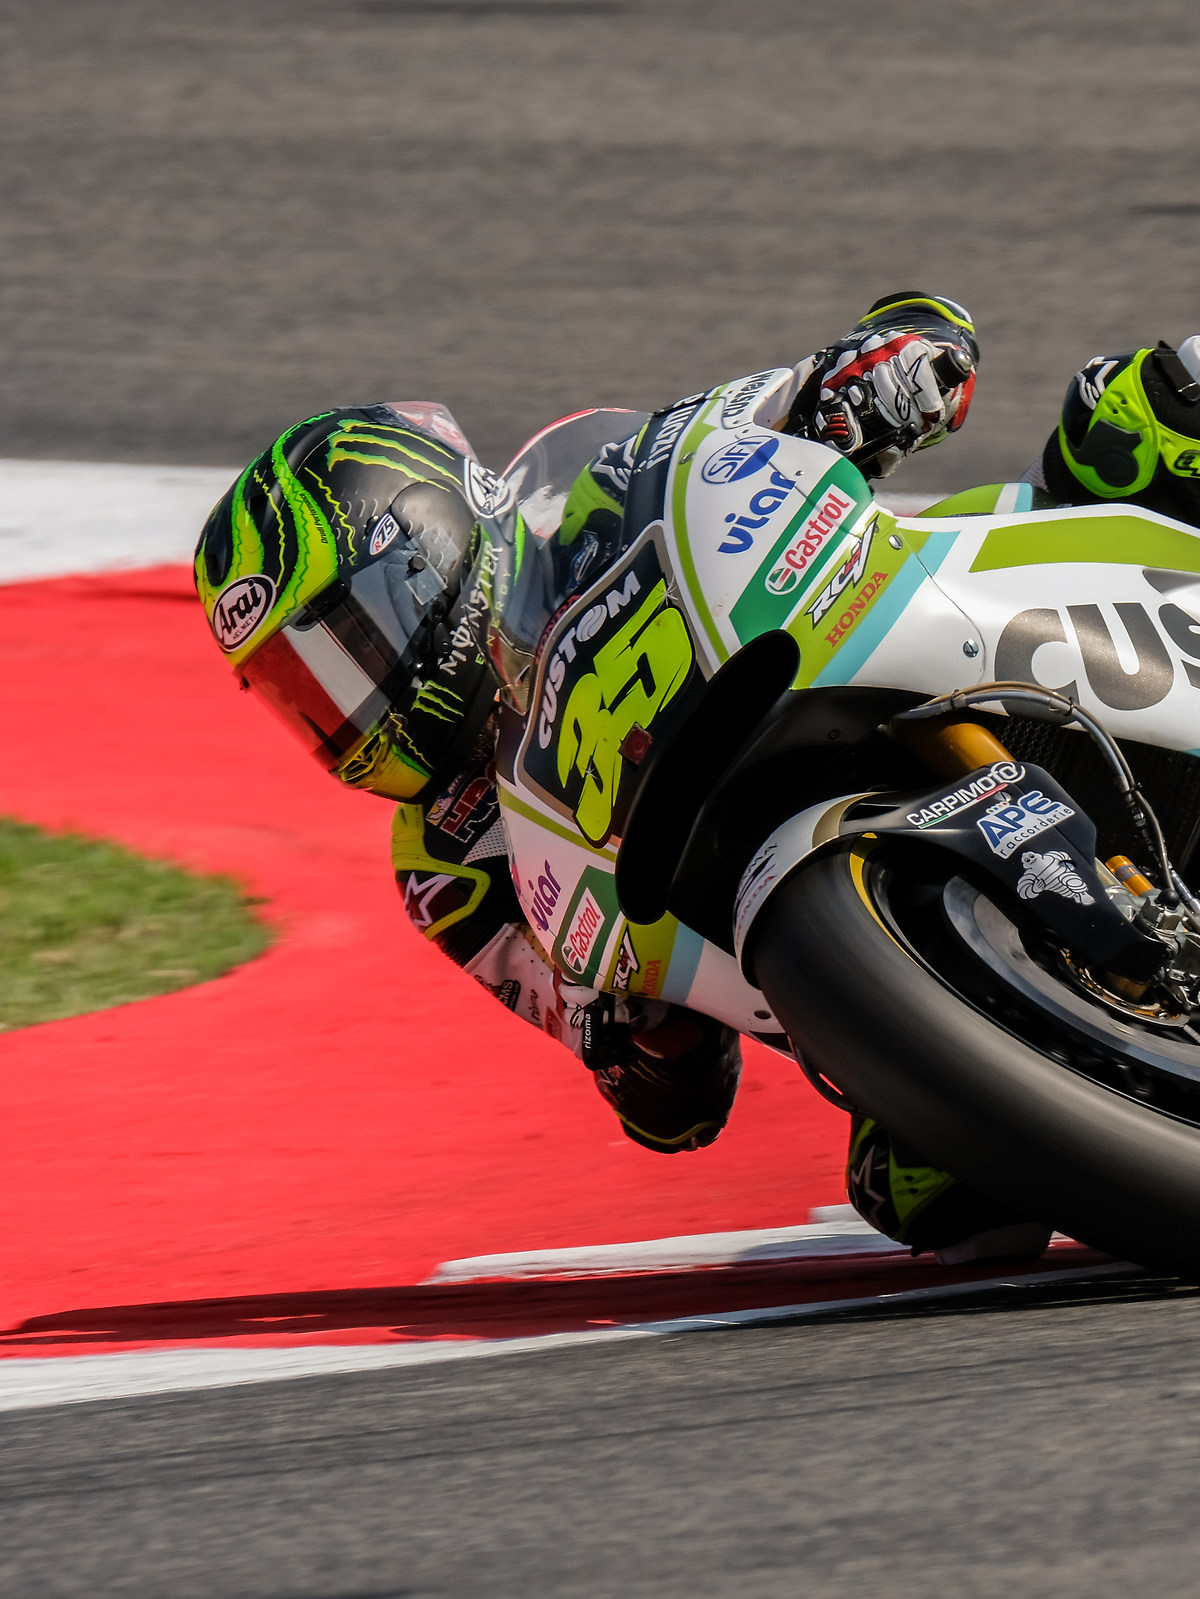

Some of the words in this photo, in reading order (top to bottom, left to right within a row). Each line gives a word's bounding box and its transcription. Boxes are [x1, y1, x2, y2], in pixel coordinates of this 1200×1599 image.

[724, 370, 776, 418] CUSTOM
[707, 440, 764, 482] SIFI
[717, 471, 798, 554] viar
[785, 493, 850, 571] Castrol
[219, 579, 263, 644] Arai
[437, 540, 503, 676] MONSTER
[475, 572, 511, 666] ENERGY
[824, 571, 888, 648] HONDA
[538, 570, 641, 749] CUSTOM
[980, 790, 1062, 849] APE
[999, 808, 1073, 857] raccorderie
[528, 860, 562, 932] viar
[570, 897, 600, 961] Castrol
[583, 1013, 591, 1049] rizoma
